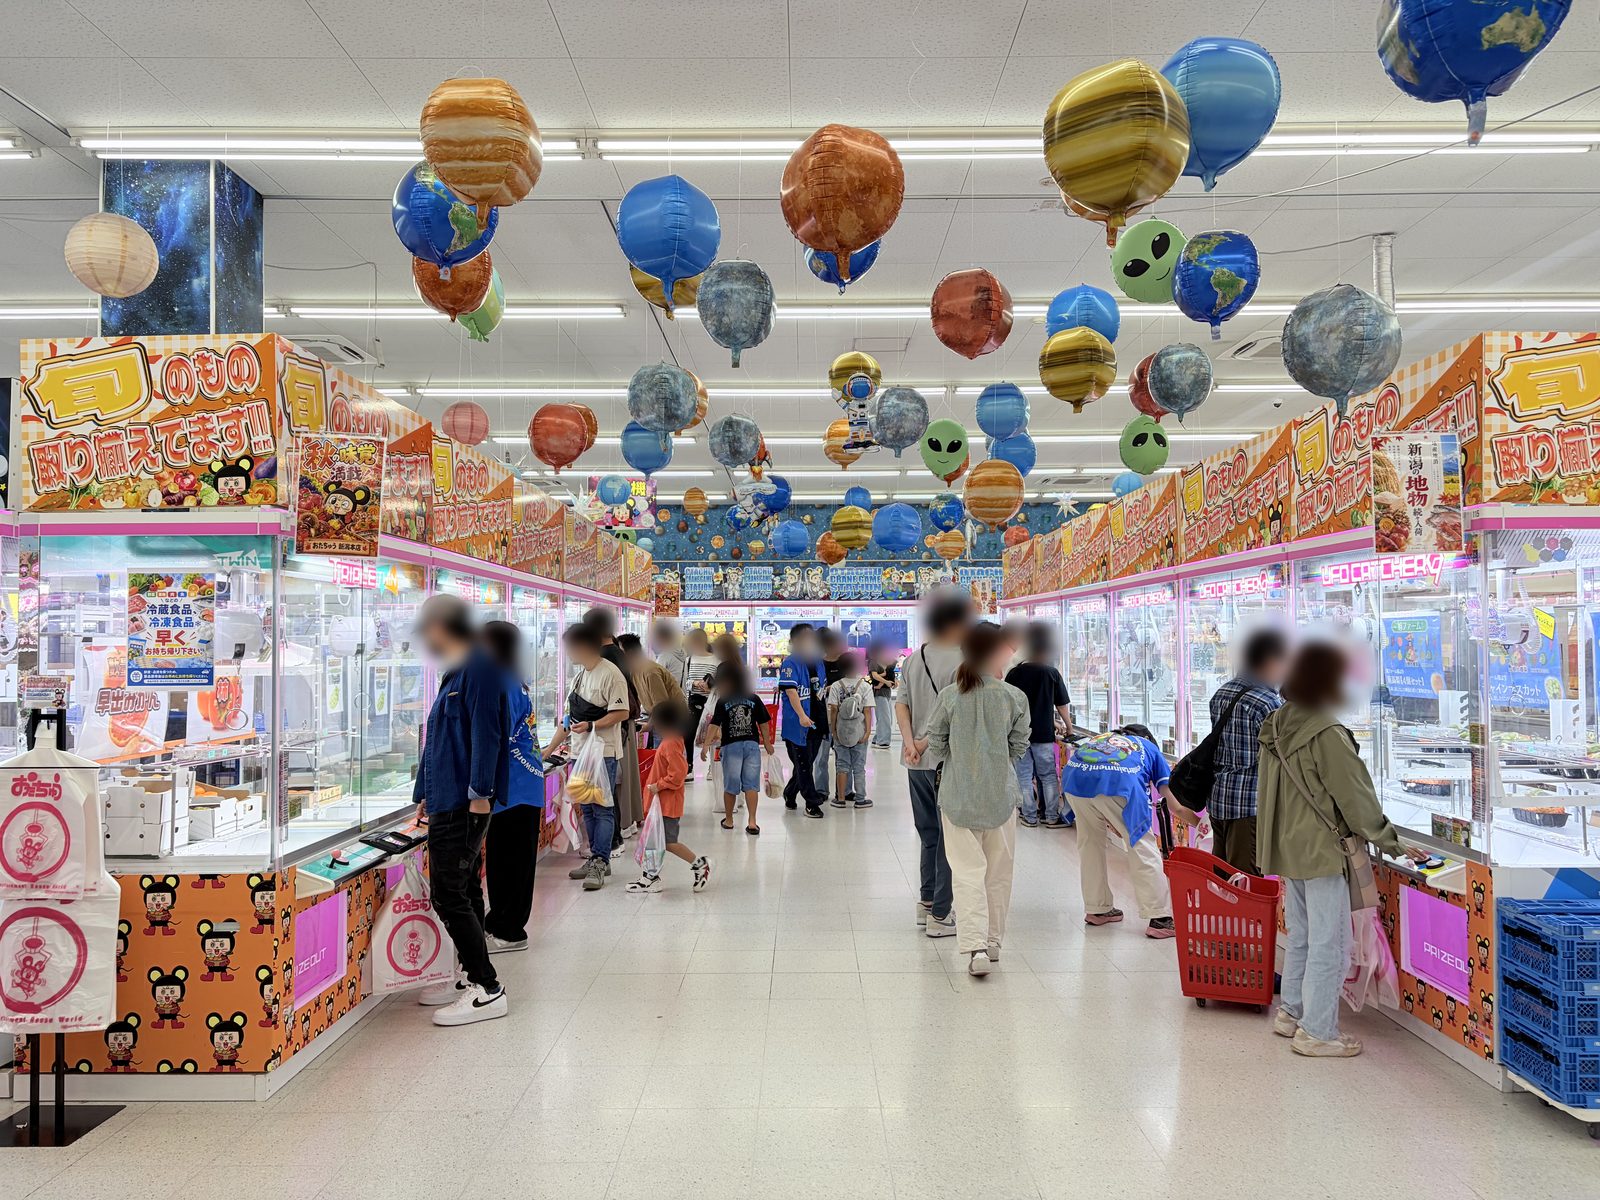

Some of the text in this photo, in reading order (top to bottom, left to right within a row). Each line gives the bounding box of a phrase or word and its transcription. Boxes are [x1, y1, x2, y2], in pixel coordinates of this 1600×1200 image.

[303, 439, 377, 472] 秋の味覚
[1490, 420, 1600, 488] 取り揃
[217, 555, 257, 567] TWIN
[155, 630, 186, 646] 早く
[96, 687, 161, 715] 早出みかん
